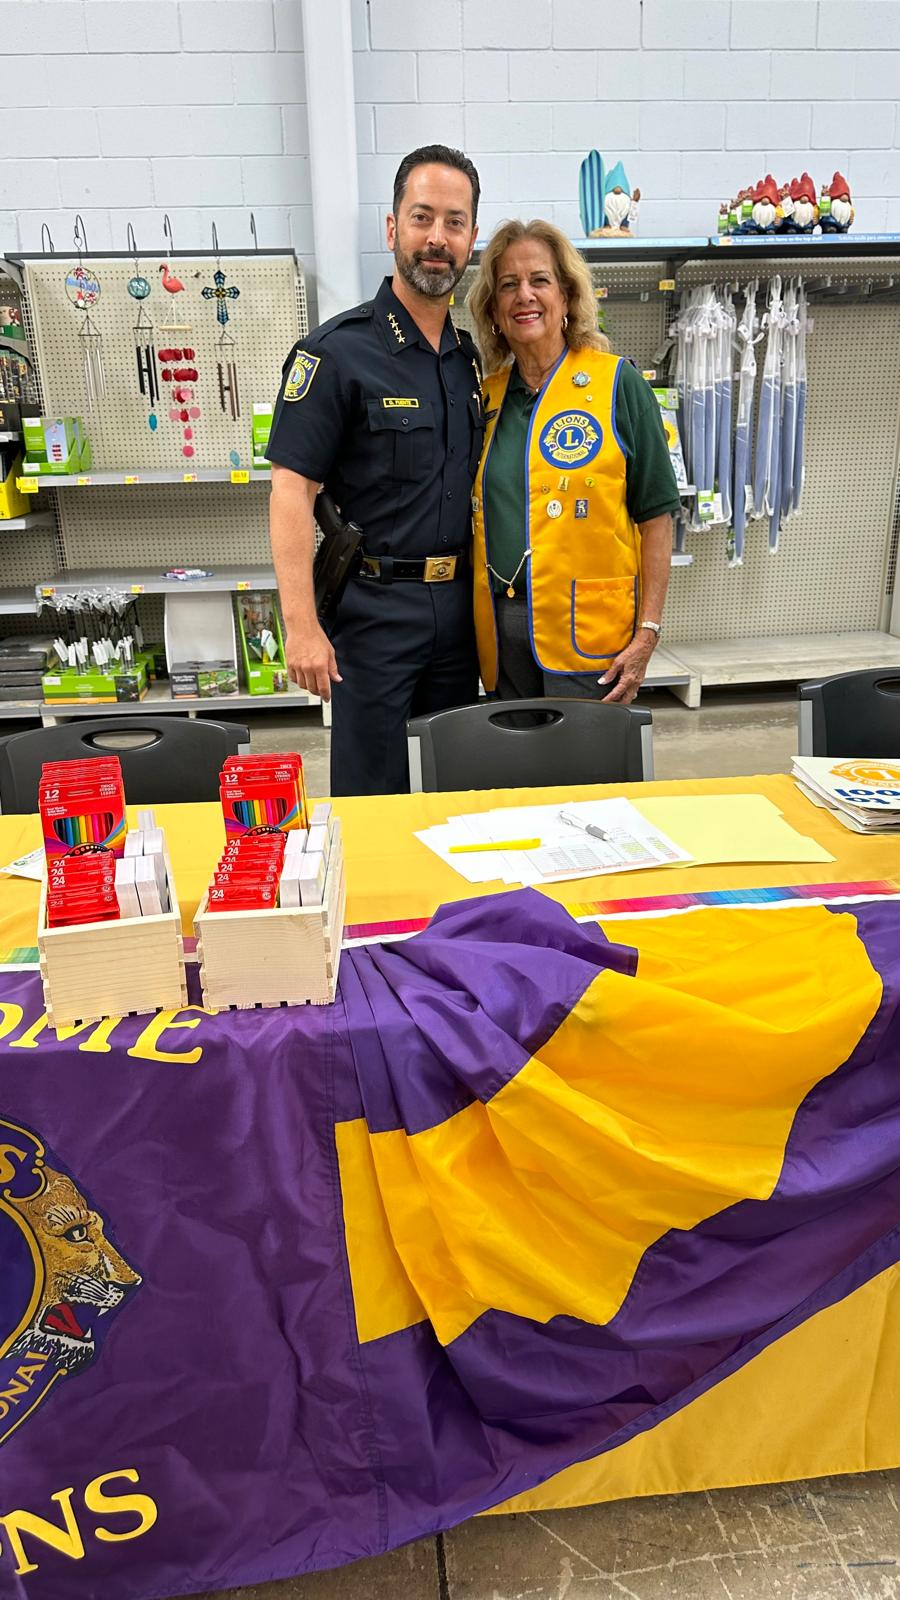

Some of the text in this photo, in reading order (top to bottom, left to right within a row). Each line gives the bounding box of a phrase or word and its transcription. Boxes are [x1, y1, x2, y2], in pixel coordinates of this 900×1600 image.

[555, 416, 587, 429] LIONS
[564, 429, 579, 447] L
[224, 773, 239, 783] 12
[44, 789, 60, 800] 12
[227, 847, 239, 855] 24
[51, 868, 64, 876] 24
[220, 863, 233, 872] 24
[52, 876, 65, 886] 24
[217, 873, 229, 881] 24
[211, 889, 224, 898] 24
